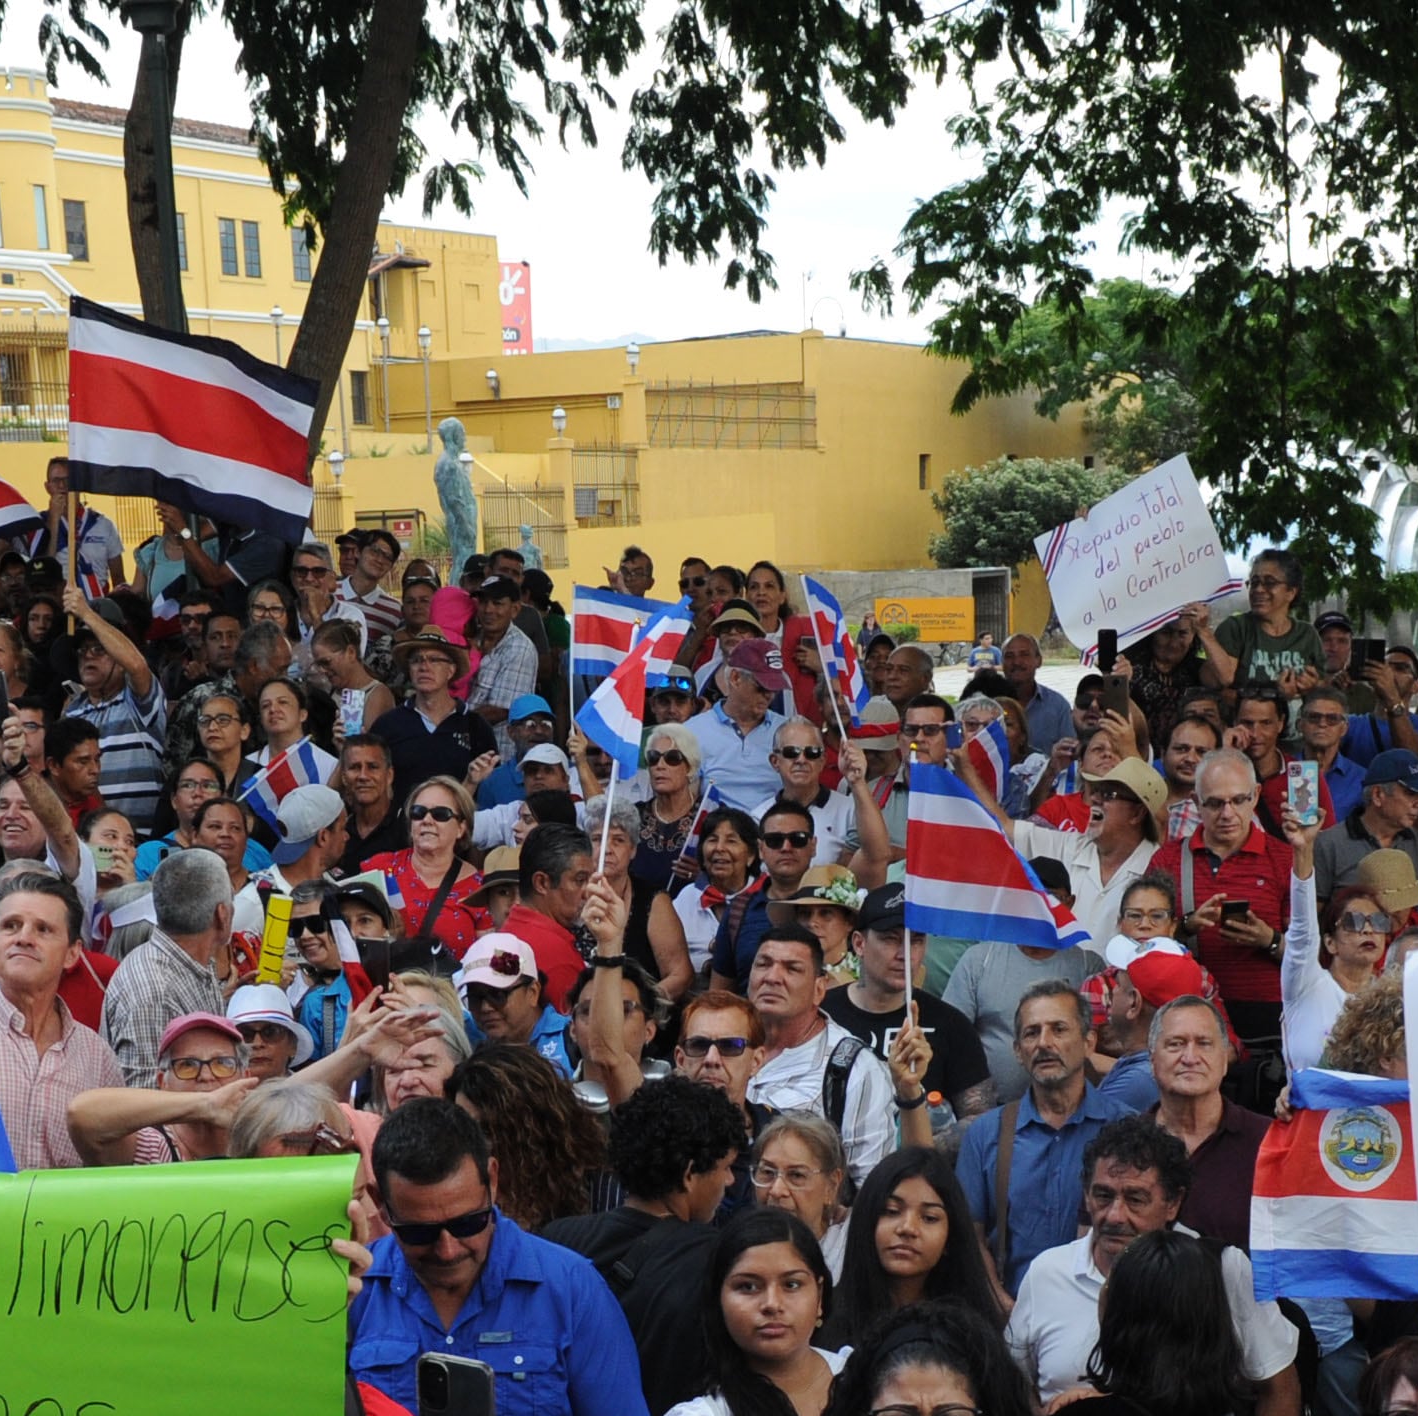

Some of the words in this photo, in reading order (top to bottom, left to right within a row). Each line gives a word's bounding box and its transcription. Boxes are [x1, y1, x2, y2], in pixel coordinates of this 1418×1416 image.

[1059, 513, 1141, 567] Repudio
[1094, 548, 1120, 579] del
[1134, 517, 1186, 565] pueblo
[1083, 611, 1095, 625] a
[1098, 589, 1117, 615] la
[1127, 542, 1215, 597] Contralora
